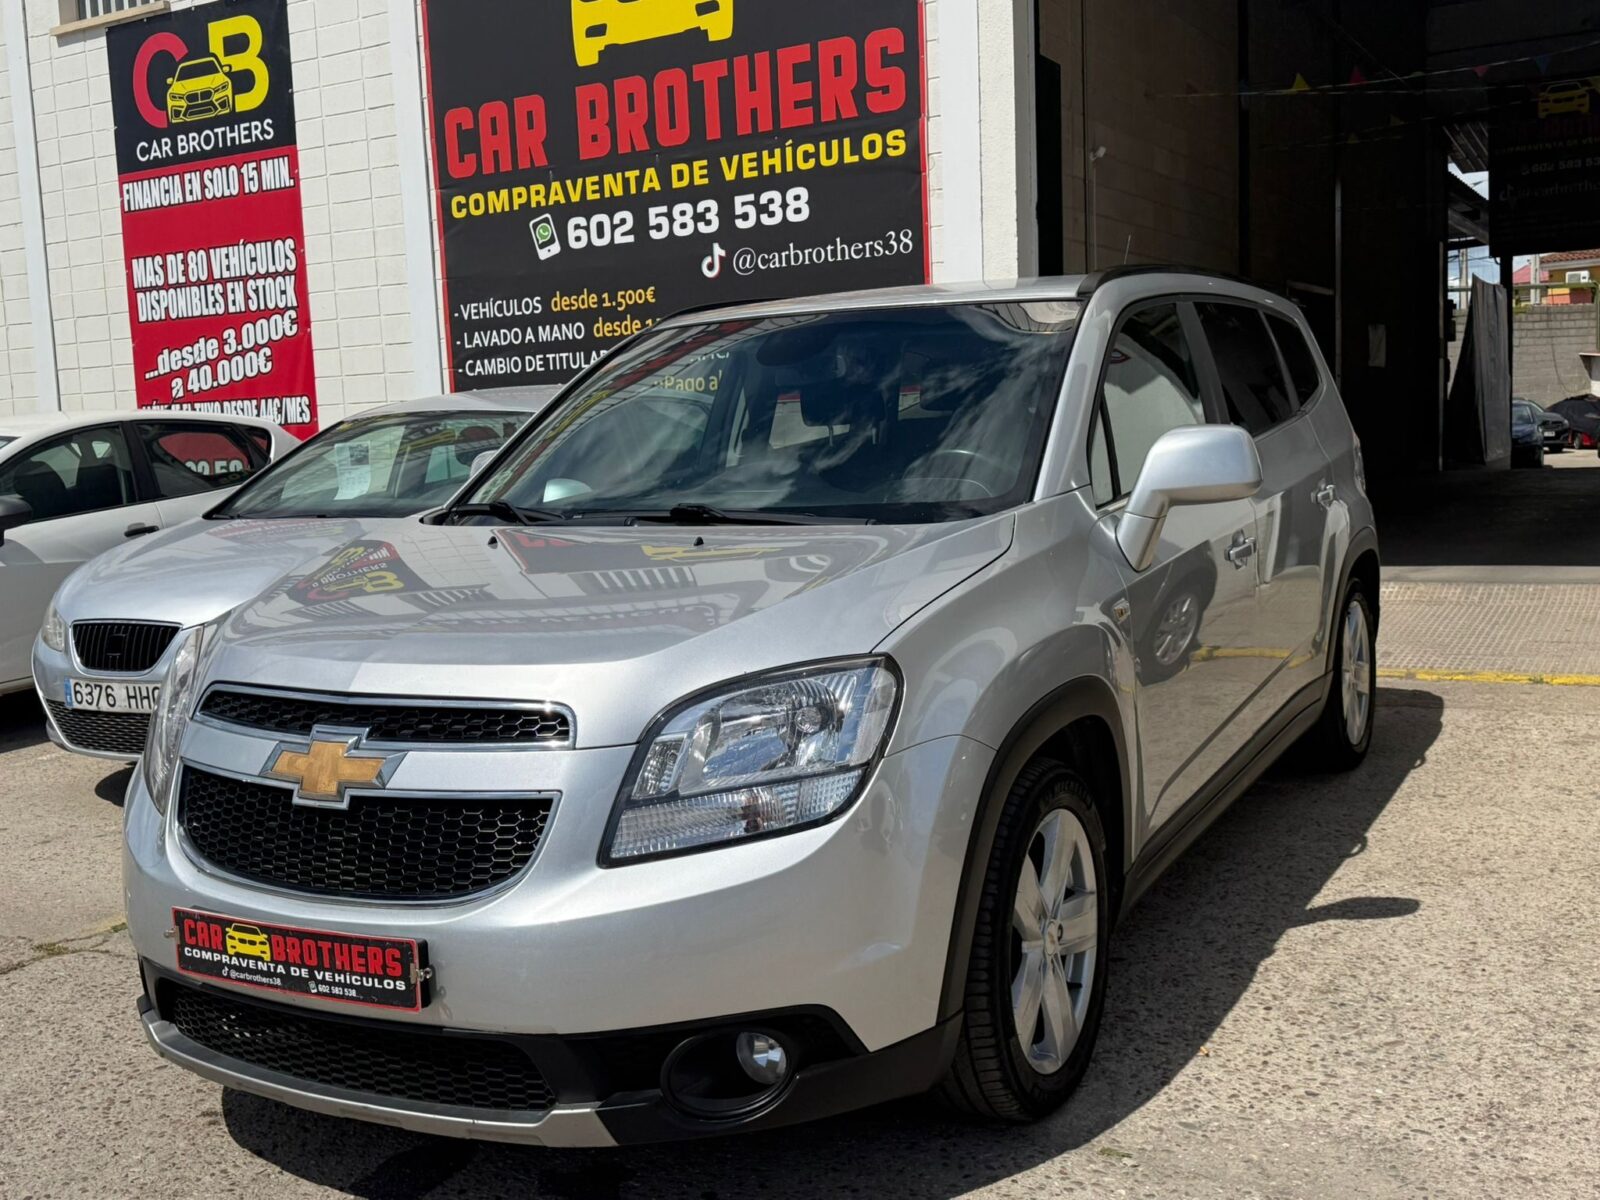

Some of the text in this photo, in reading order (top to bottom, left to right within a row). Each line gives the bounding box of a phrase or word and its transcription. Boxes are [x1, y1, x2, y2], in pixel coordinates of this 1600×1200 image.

[444, 27, 906, 178] CAR BROTHERS
[136, 118, 274, 162] CAR BROTHERS
[122, 156, 295, 212] FINANCIA EN SOLO 15 MIN.
[451, 128, 907, 219] COMPRAVENTA DE VEHÍCULOS
[567, 186, 810, 250] 602 583 538
[131, 238, 297, 289] MAS DE 80 VEHÍCULOS
[733, 228, 914, 276] @carbrothers38
[136, 274, 298, 323] DISPONIBLES EN STOCK
[551, 288, 598, 312] desde
[601, 286, 656, 311] 1.500€
[222, 309, 298, 355] 3.000€
[463, 327, 522, 348] LAVADO
[524, 328, 536, 344] A
[538, 322, 585, 343] MANO
[593, 314, 641, 338] desde
[187, 347, 273, 394] 40.000€
[465, 356, 522, 377] CAMBIO
[524, 353, 545, 373] DE
[73, 681, 116, 708] 6376
[183, 918, 402, 977] CAR BROTHERS
[184, 946, 406, 991] COMPRAVENTA DE VEHÍCULOS
[229, 968, 282, 986] @carbrothers38
[318, 984, 330, 993] 602
